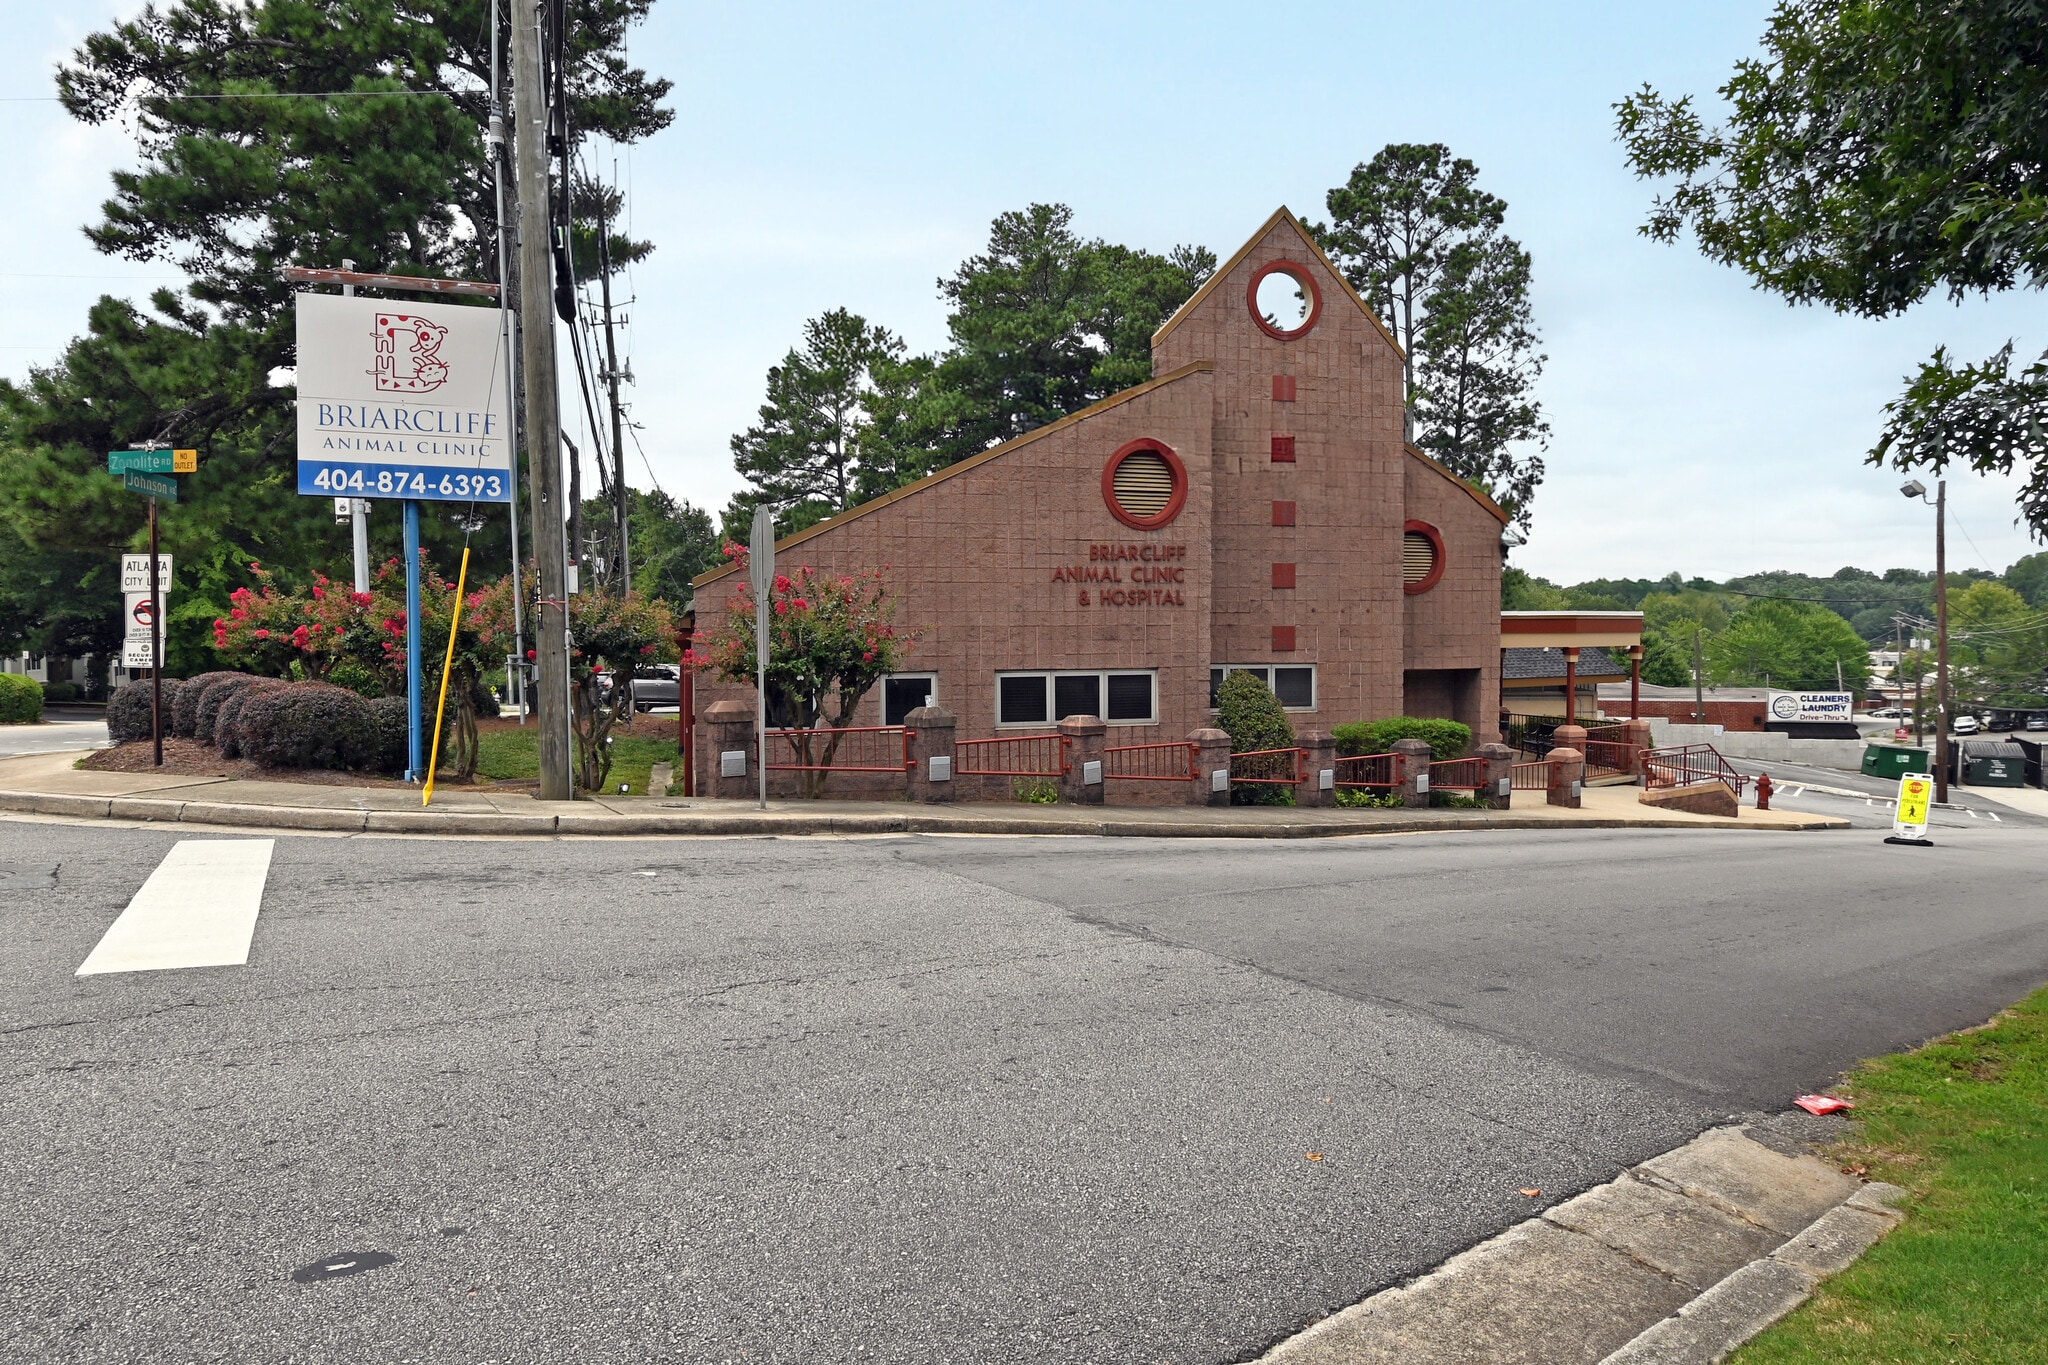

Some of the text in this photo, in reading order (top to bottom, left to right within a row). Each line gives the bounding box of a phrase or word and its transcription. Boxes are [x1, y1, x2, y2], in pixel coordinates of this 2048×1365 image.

[318, 403, 497, 435] BRIARCLIFF
[323, 437, 490, 456] ANIMAL CLINIC
[111, 454, 160, 469] Zonolite
[180, 452, 188, 460] NO
[175, 461, 193, 470] OUTLET
[127, 472, 167, 494] Johnson
[313, 468, 502, 497] 404-874-6393
[1089, 544, 1187, 562] BRIARCLIFF
[125, 561, 168, 572] ATLATA
[1052, 566, 1185, 583] ANIMAL CLINIC
[125, 576, 167, 586] CITY LIT
[1078, 589, 1185, 606] & HOSPITAL
[1802, 704, 1847, 712] LAUNDRY
